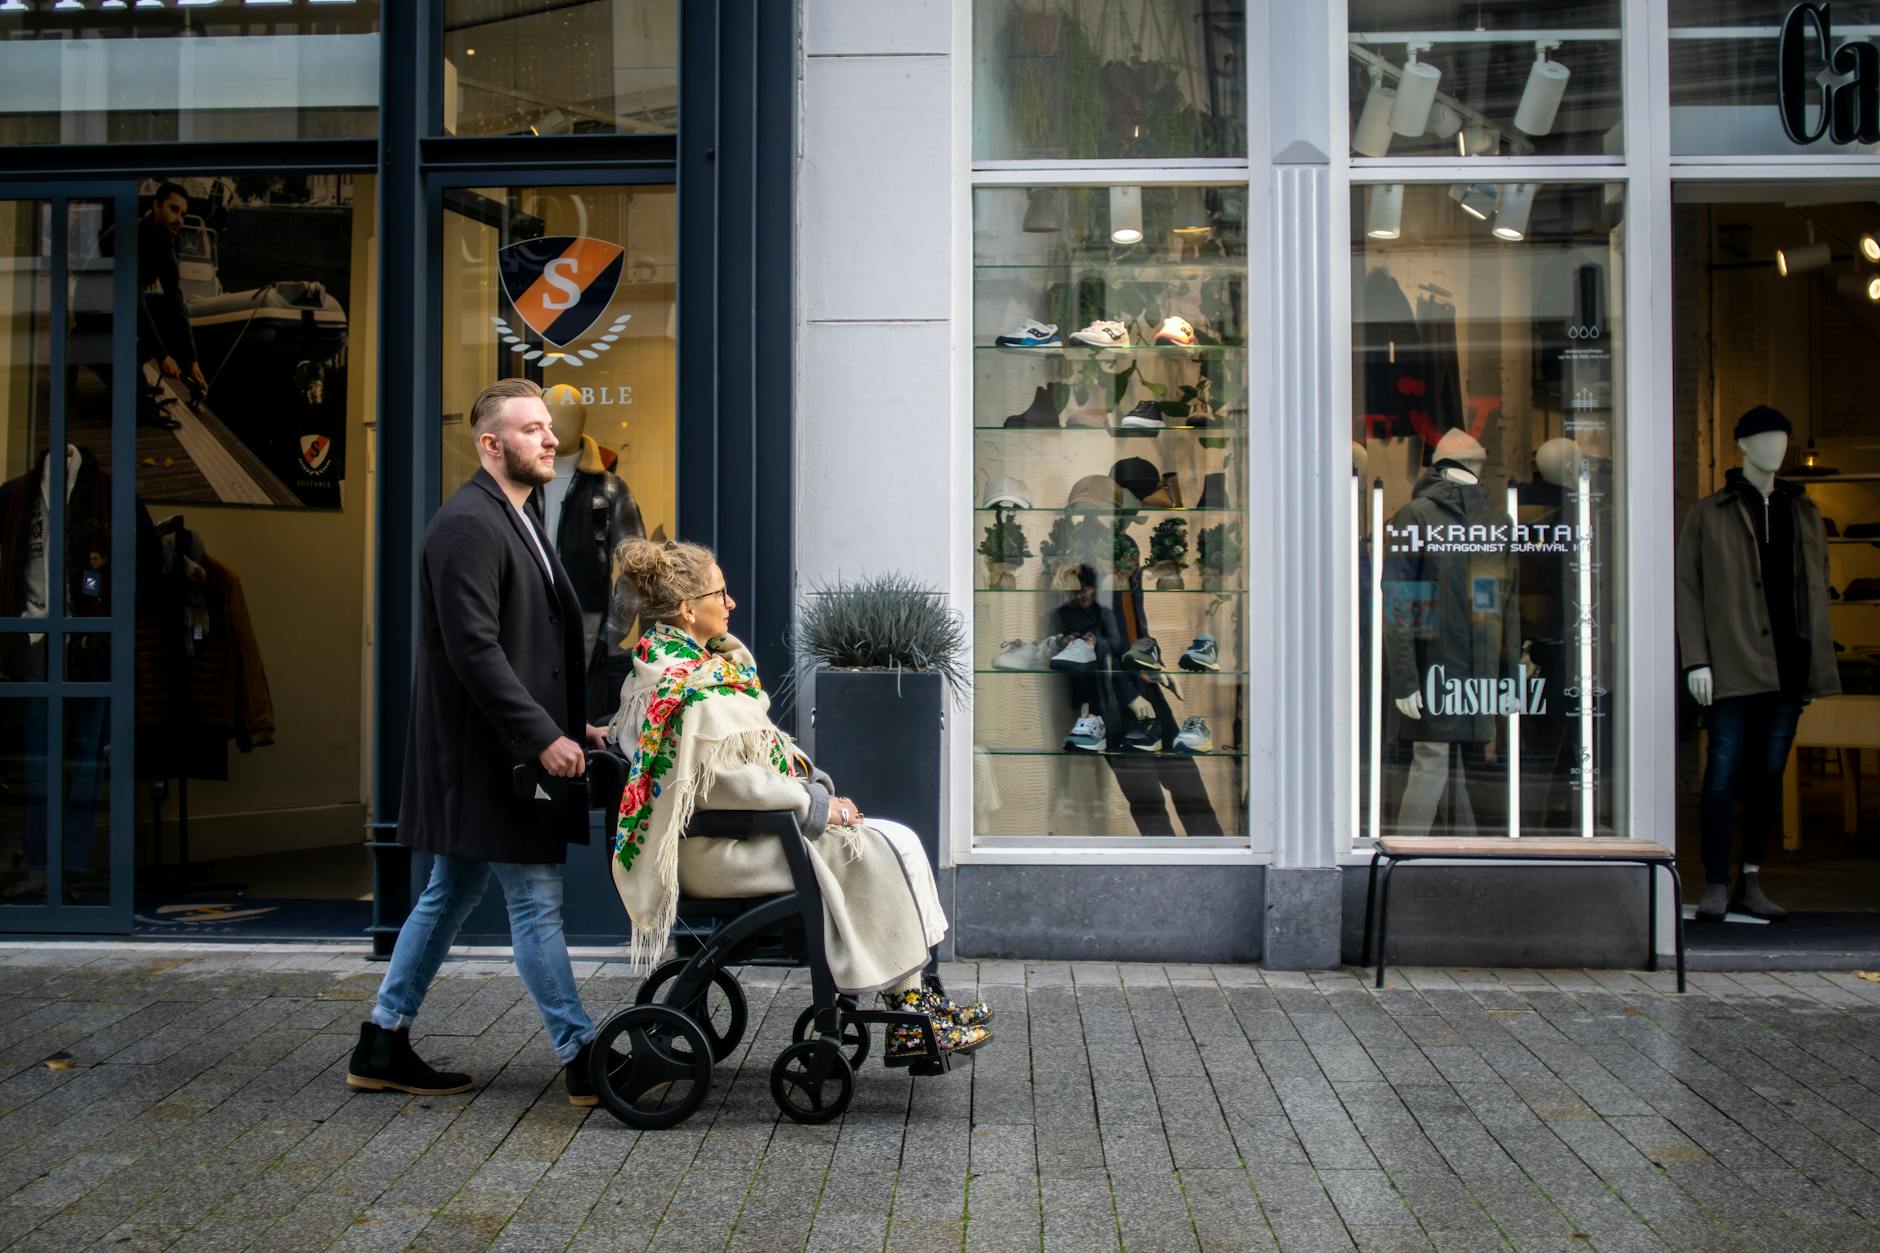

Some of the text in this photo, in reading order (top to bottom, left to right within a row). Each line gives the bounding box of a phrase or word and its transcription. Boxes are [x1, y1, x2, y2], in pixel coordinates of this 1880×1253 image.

[542, 257, 581, 310] S
[541, 386, 633, 405] TABLE
[1427, 543, 1505, 552] ANTAGONIST
[1510, 543, 1569, 552] SURVIVAL
[1426, 663, 1547, 716] Casualz
